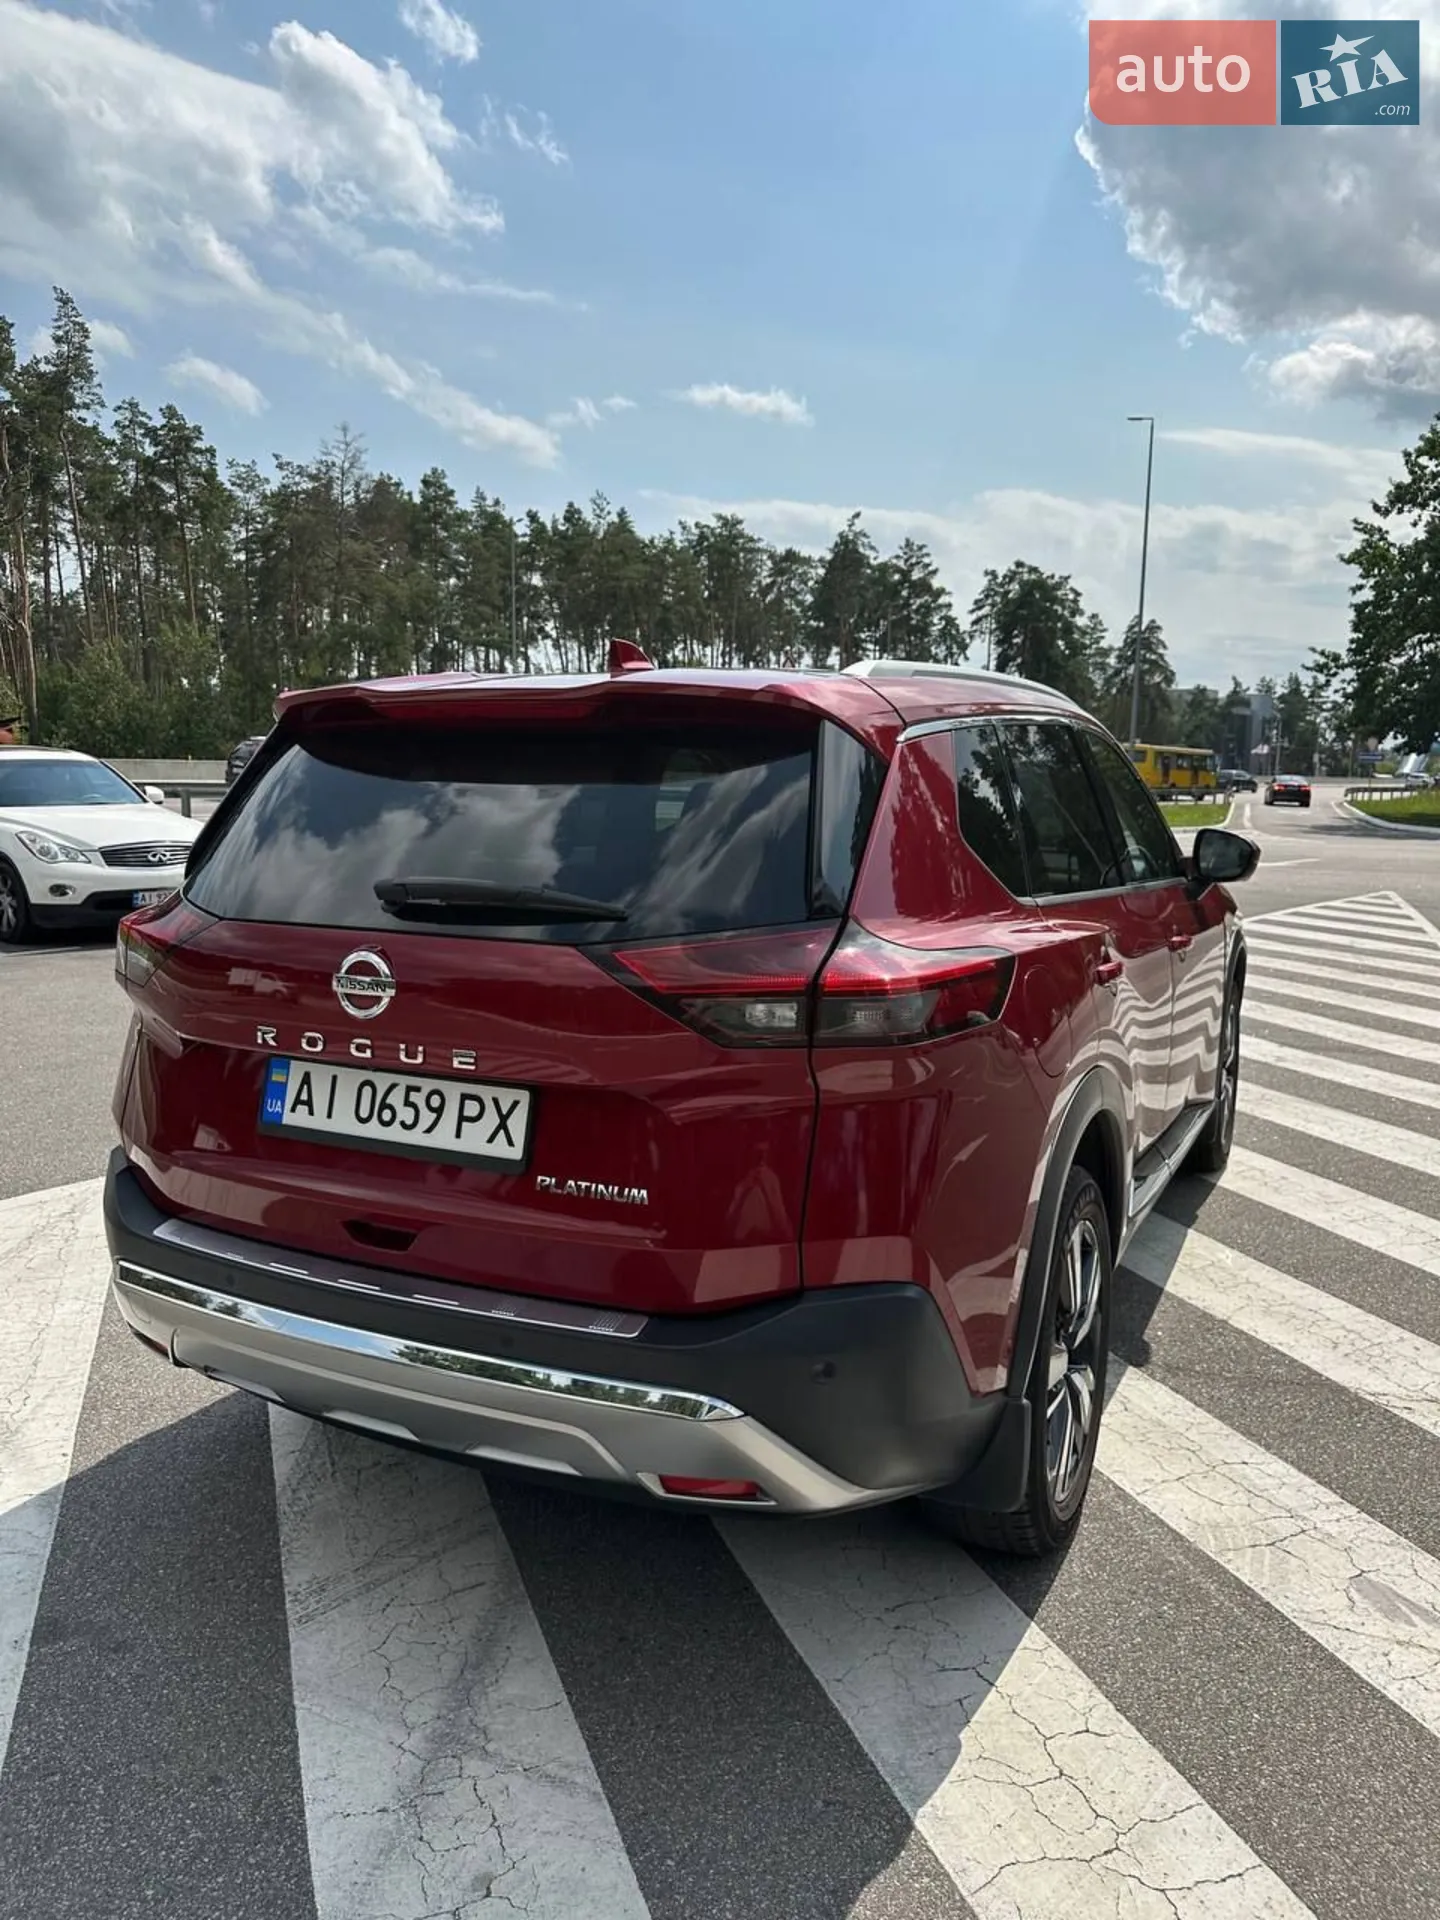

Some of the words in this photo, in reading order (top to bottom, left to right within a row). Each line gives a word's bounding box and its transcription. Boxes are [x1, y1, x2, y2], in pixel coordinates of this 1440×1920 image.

[336, 976, 387, 992] NISSAN
[256, 1025, 477, 1070] ROGUE
[267, 1098, 282, 1114] UA
[290, 1071, 338, 1119] AI
[355, 1078, 447, 1135] 0659
[455, 1093, 521, 1148] PX
[535, 1175, 649, 1204] PLATINUM
